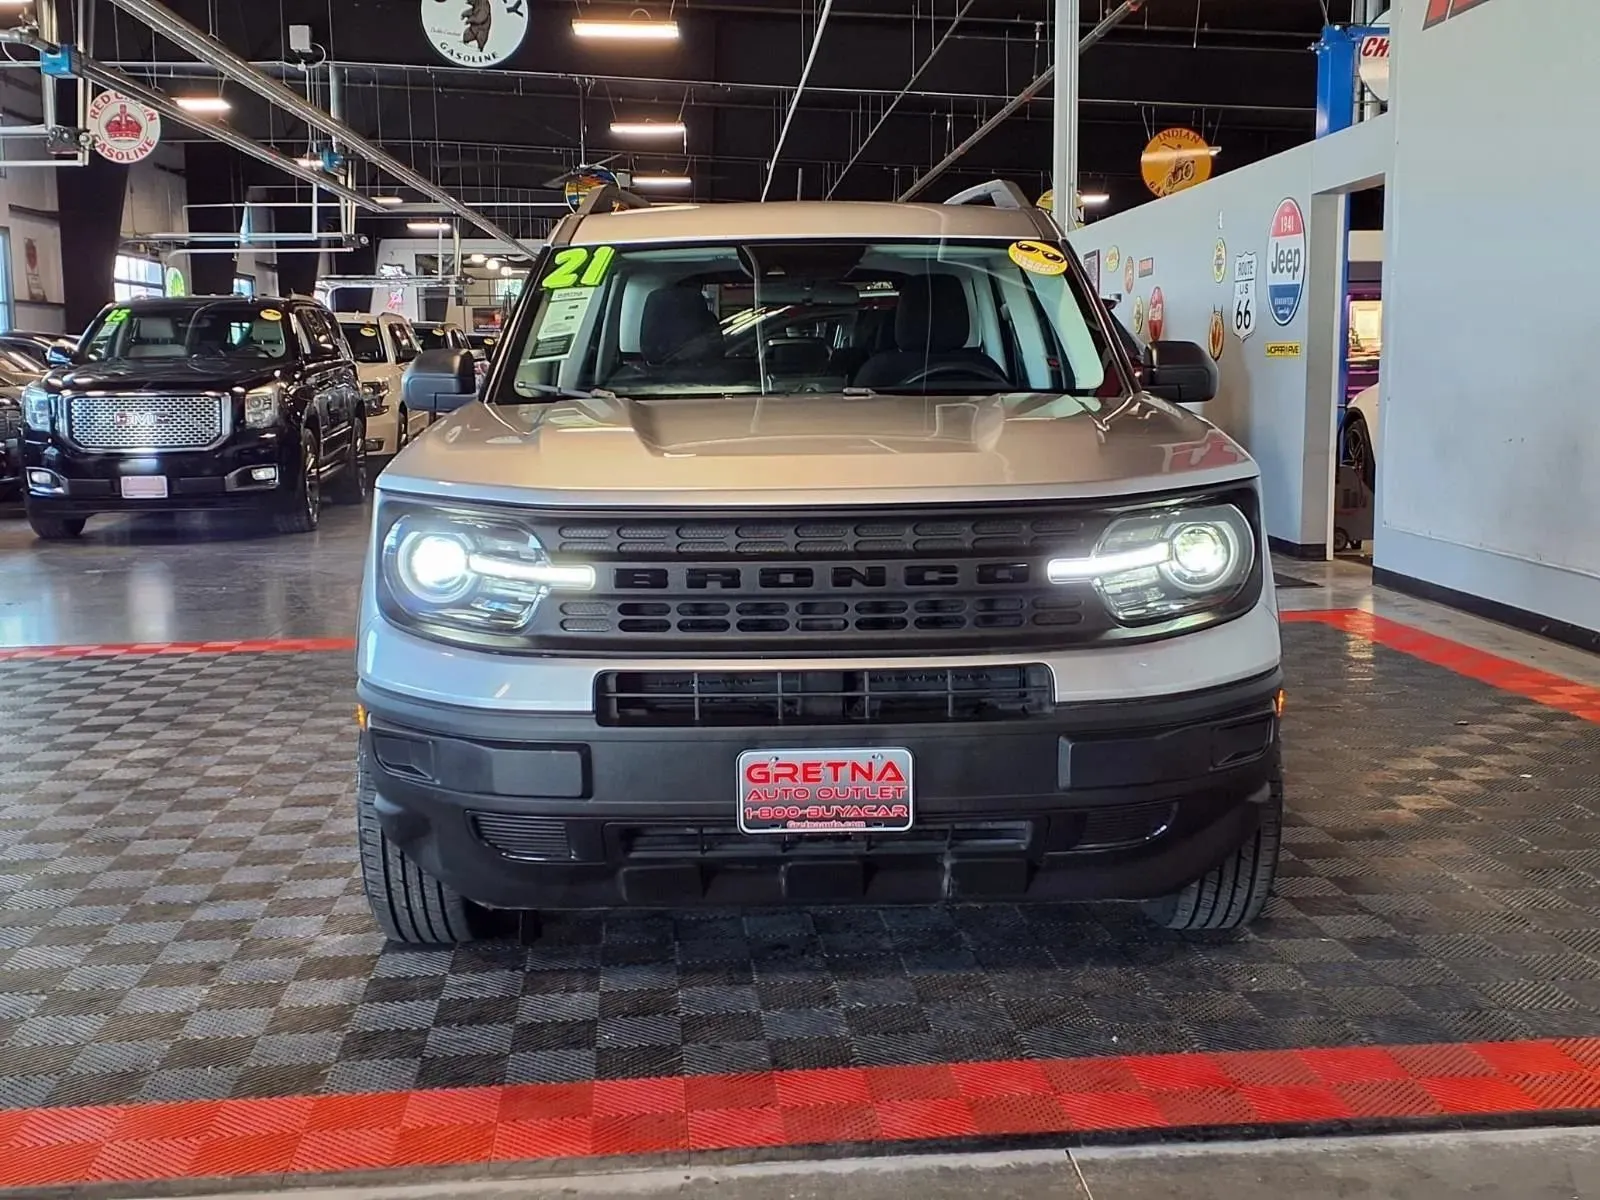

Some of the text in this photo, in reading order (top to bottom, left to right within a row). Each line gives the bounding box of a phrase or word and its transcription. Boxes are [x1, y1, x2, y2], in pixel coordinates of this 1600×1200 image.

[440, 42, 498, 62] GASOLINE
[90, 94, 111, 119] RED
[1158, 130, 1200, 144] INDIAN
[1281, 215, 1294, 232] 1941
[541, 246, 615, 289] 21
[1238, 261, 1253, 276] ROUTE
[1271, 241, 1300, 280] Jeep
[1240, 283, 1249, 294] US
[1236, 299, 1251, 330] 66
[614, 562, 1030, 588] BRONCO
[746, 761, 906, 784] GRETNA
[746, 786, 907, 800] AUTO OUTLET
[745, 805, 908, 820] 1-800-BUYACAR
